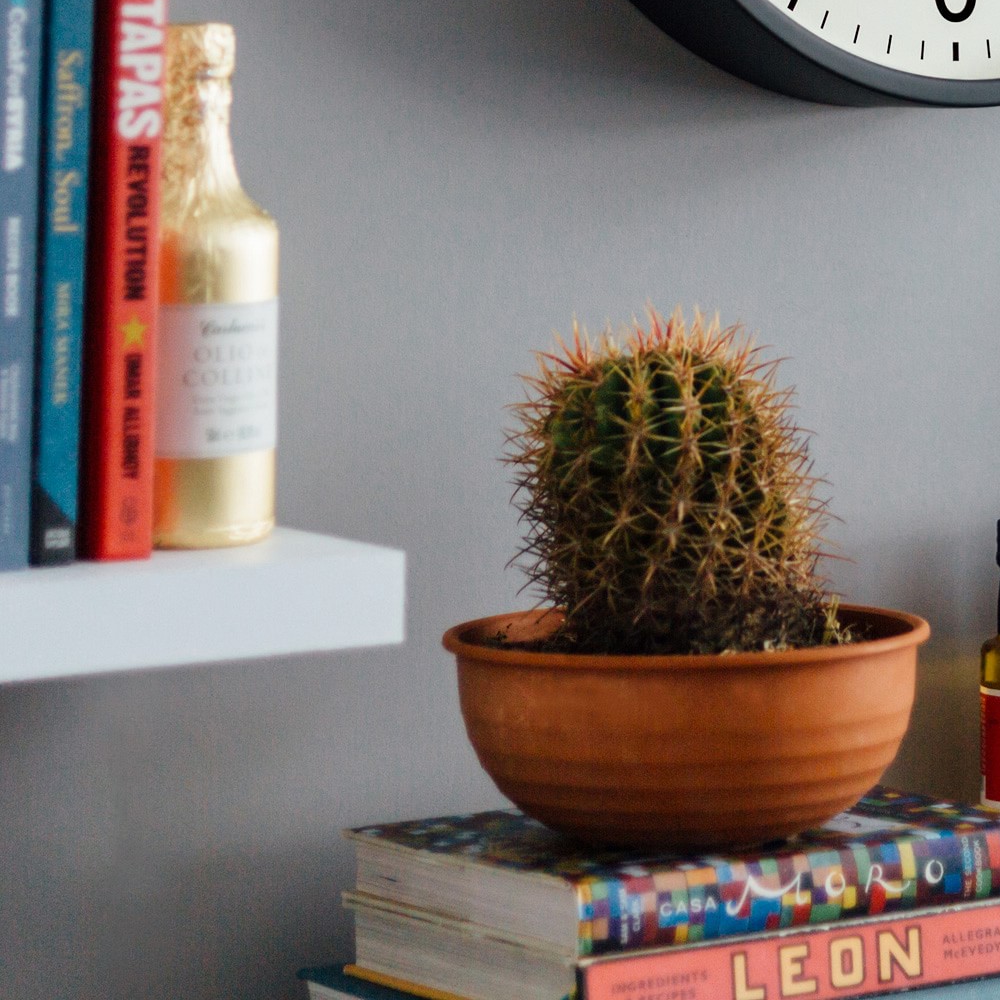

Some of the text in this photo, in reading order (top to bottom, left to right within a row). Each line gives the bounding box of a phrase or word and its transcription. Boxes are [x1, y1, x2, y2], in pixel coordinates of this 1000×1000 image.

[53, 170, 79, 233] Soul
[122, 146, 150, 302] REVOLUTION
[961, 835, 973, 877] SECOND
[974, 839, 983, 893] COOKBOOK
[659, 897, 717, 917] CASA
[612, 969, 708, 995] INGREDIENTS
[730, 925, 923, 1000] LEON
